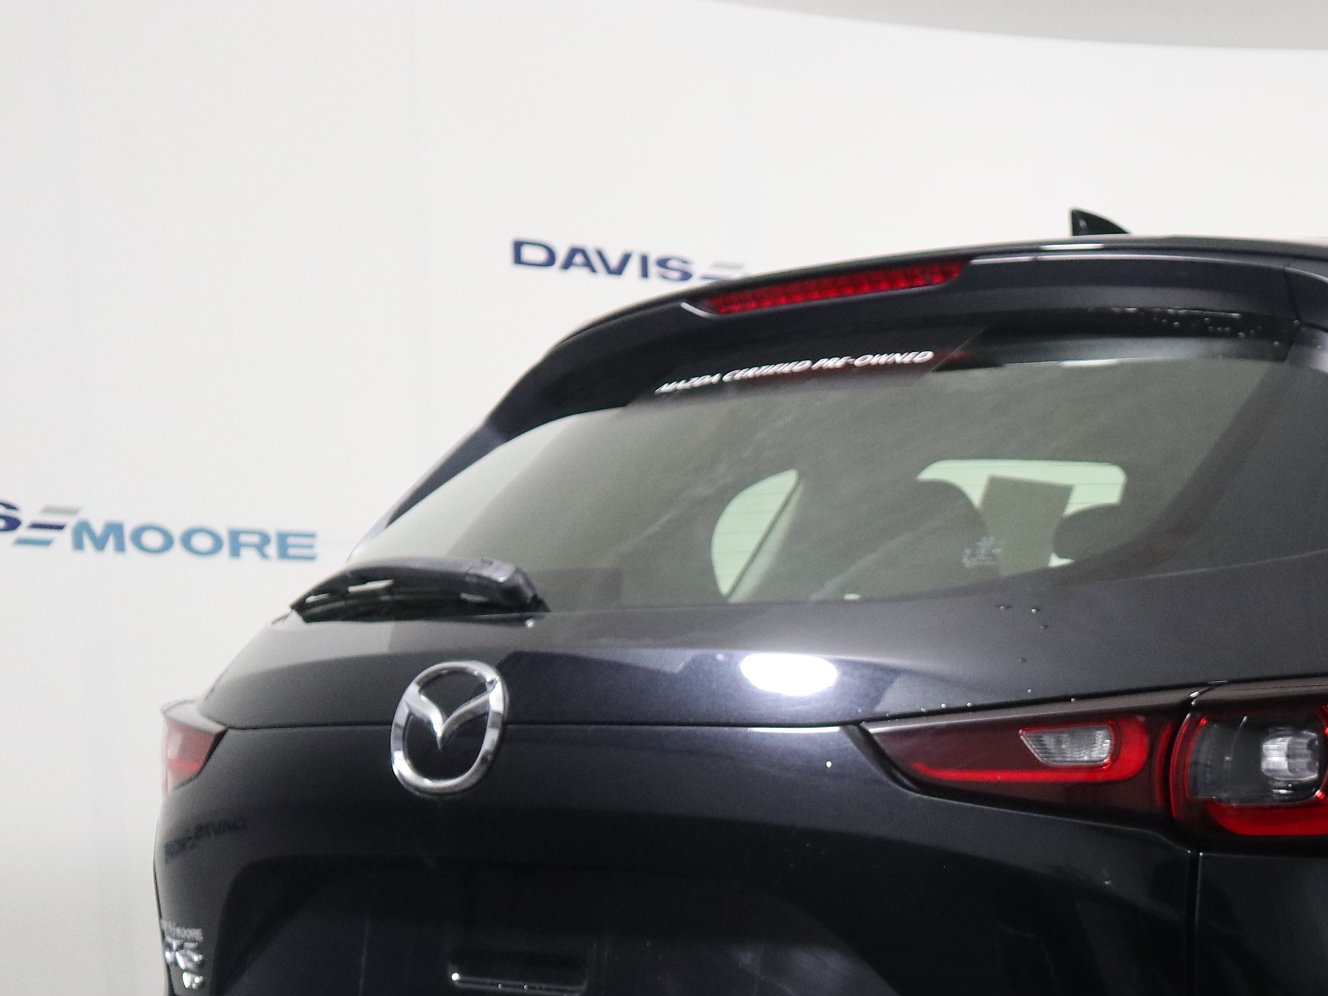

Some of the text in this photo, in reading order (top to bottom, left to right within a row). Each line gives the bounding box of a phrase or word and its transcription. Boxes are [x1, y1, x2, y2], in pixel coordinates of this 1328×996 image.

[512, 239, 693, 281] DAVIS
[654, 373, 721, 394] MAZDA
[71, 519, 318, 561] MOORE
